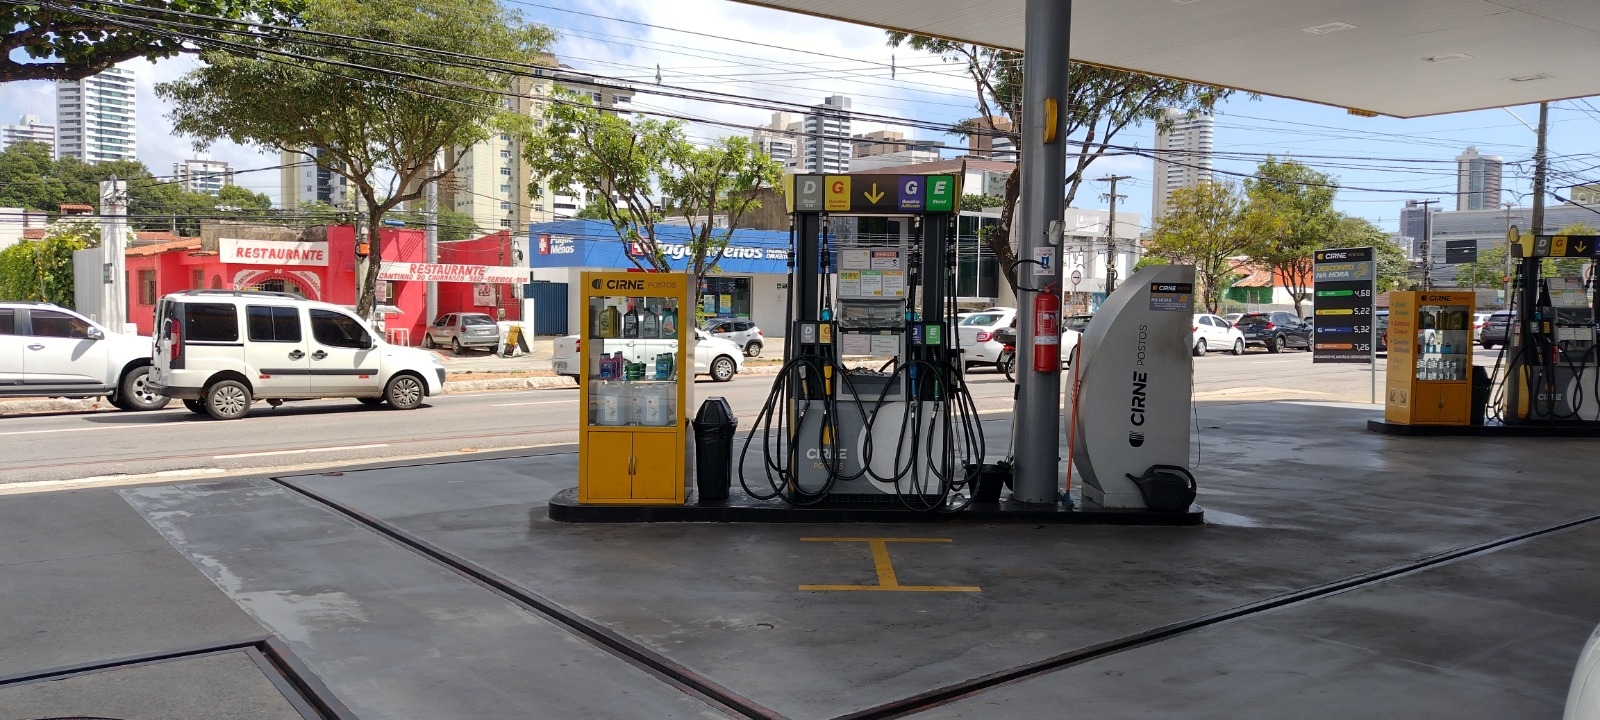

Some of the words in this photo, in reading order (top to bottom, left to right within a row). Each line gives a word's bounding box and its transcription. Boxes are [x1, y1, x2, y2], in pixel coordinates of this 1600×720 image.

[803, 181, 816, 194] D
[905, 181, 918, 195] G
[934, 181, 947, 195] E
[1539, 239, 1547, 247] D
[236, 247, 324, 261] RESTAURANTE
[550, 245, 575, 255] Menos
[1325, 252, 1347, 260] CIRNE
[410, 264, 485, 276] RESTAURANTE
[1316, 264, 1354, 272] DESCONTO
[606, 280, 645, 290] CIRNE
[1354, 290, 1371, 298] 4,68
[1354, 307, 1370, 316] 5,22
[804, 326, 812, 334] D
[1353, 325, 1370, 334] 5,32
[1137, 324, 1148, 367] POSTOS
[1354, 343, 1370, 351] 7,26
[1130, 371, 1148, 427] CIRNE
